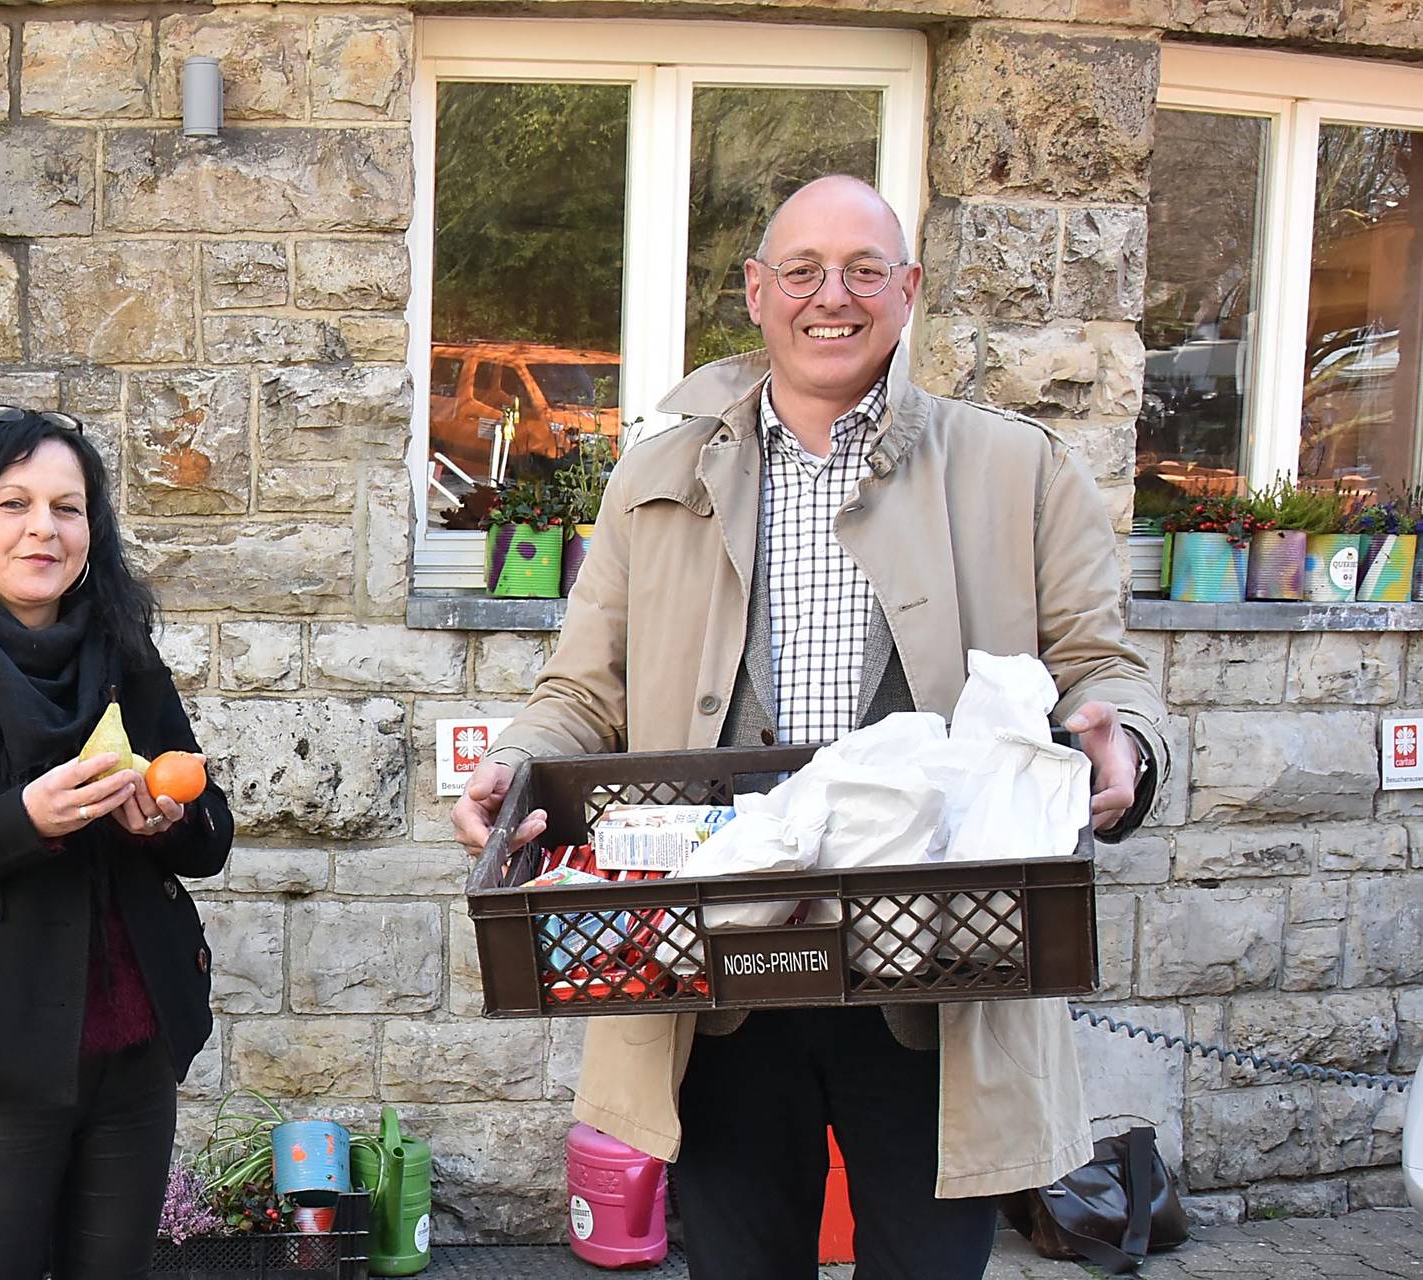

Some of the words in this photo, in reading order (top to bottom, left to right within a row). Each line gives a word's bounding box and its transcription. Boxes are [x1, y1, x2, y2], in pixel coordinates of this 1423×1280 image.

[455, 762, 478, 771] carit
[441, 782, 466, 790] Besuc
[723, 950, 829, 976] NOBIS-PRINTEN
